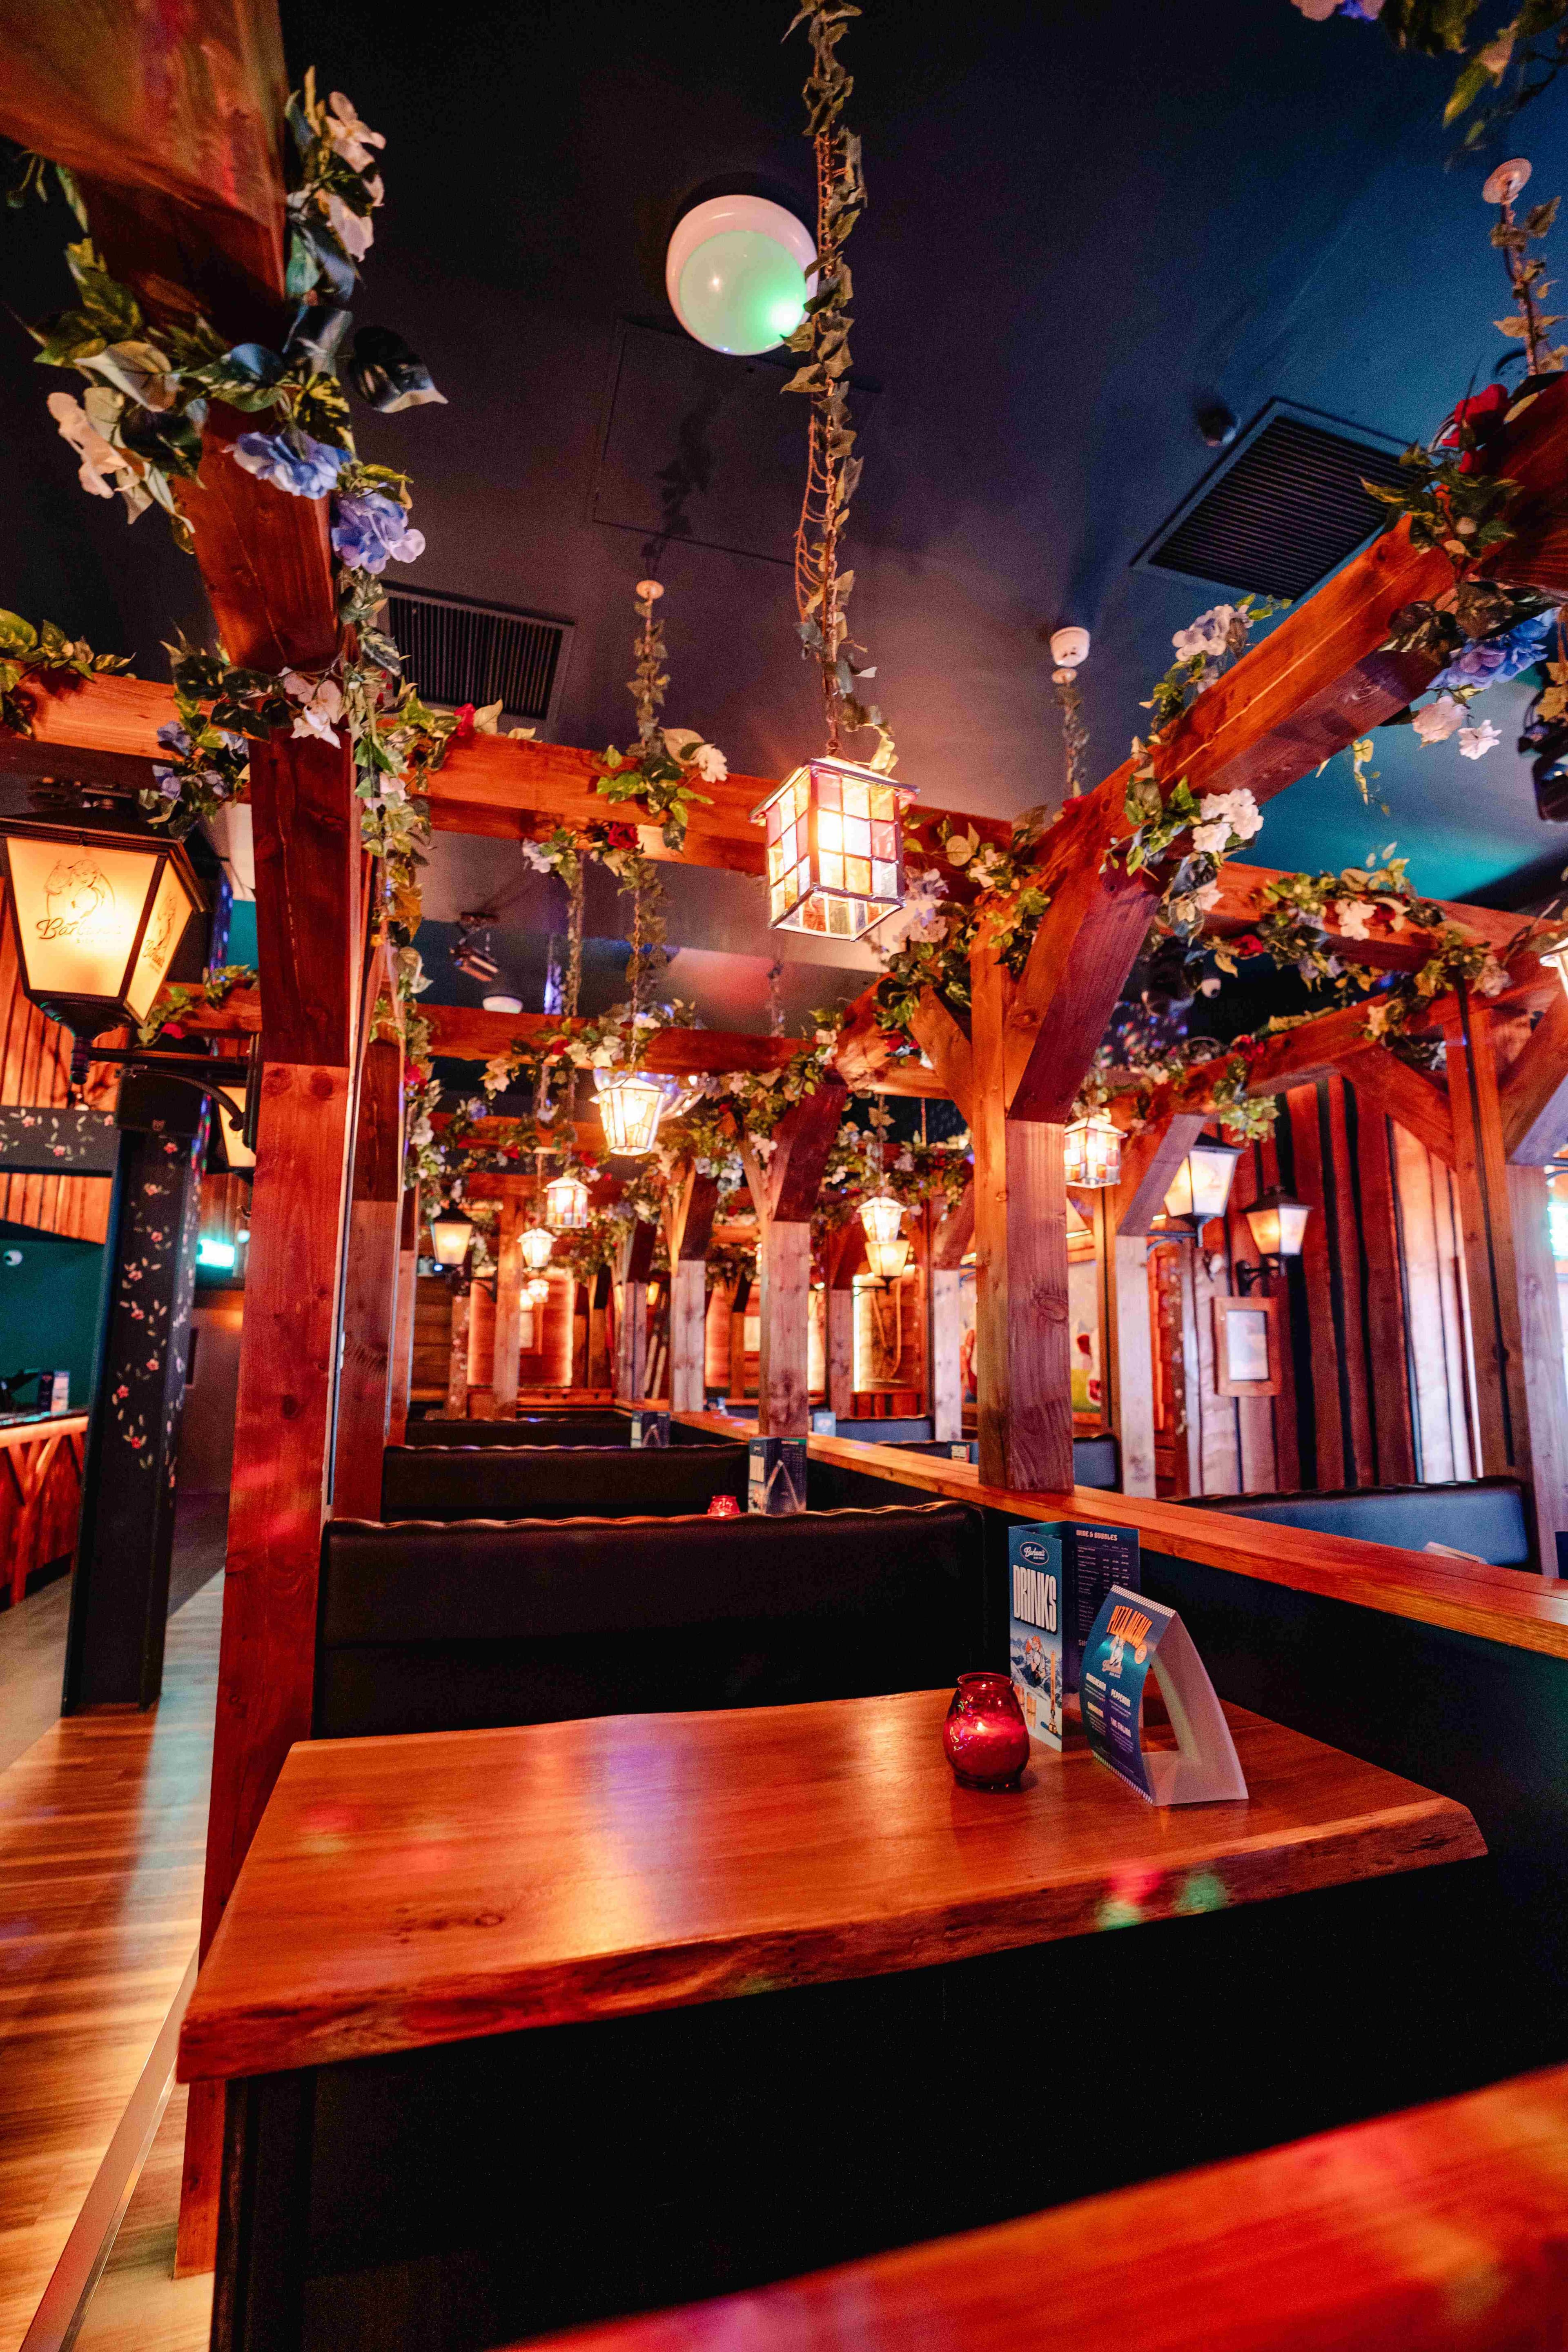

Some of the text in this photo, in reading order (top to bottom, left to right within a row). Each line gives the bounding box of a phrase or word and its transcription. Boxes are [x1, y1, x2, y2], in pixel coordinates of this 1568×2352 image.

[1076, 1530, 1089, 1538] WINE
[1094, 1532, 1118, 1541] BUBBLES
[1013, 1564, 1057, 1633] DRINKS
[1106, 1605, 1133, 1637] PIZZA
